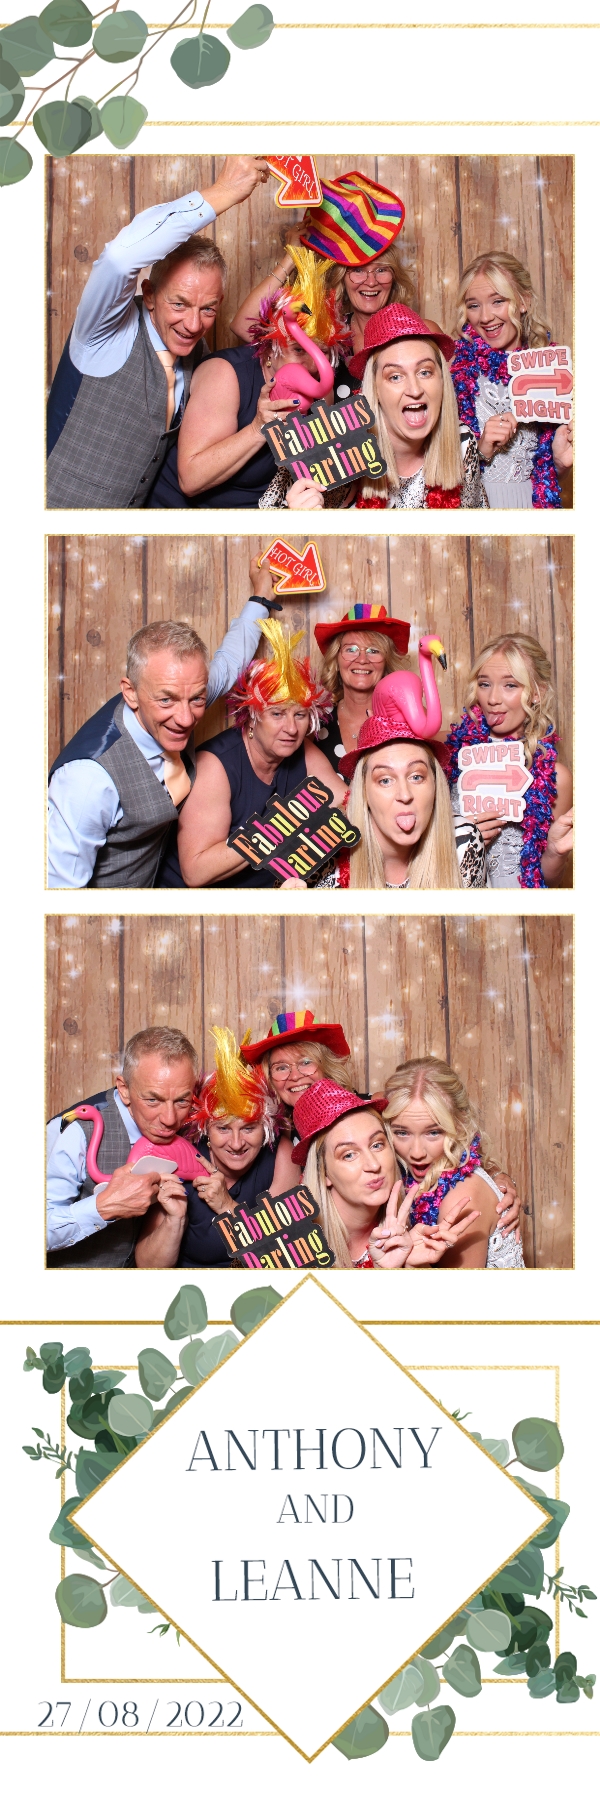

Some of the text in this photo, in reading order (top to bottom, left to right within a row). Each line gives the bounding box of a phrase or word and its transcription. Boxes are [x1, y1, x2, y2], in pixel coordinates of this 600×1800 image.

[292, 164, 316, 199] GIRL
[511, 349, 569, 371] SWIPE
[514, 400, 572, 420] RIGHT
[267, 399, 371, 461] Fabulous
[291, 439, 383, 487] Darling
[270, 548, 317, 587] HOT GIRL
[461, 744, 521, 766] SWIPE
[232, 780, 329, 865] Fabulous
[462, 795, 521, 818] RIGHT
[268, 813, 356, 880] Darling
[217, 1190, 315, 1254] Fabulous
